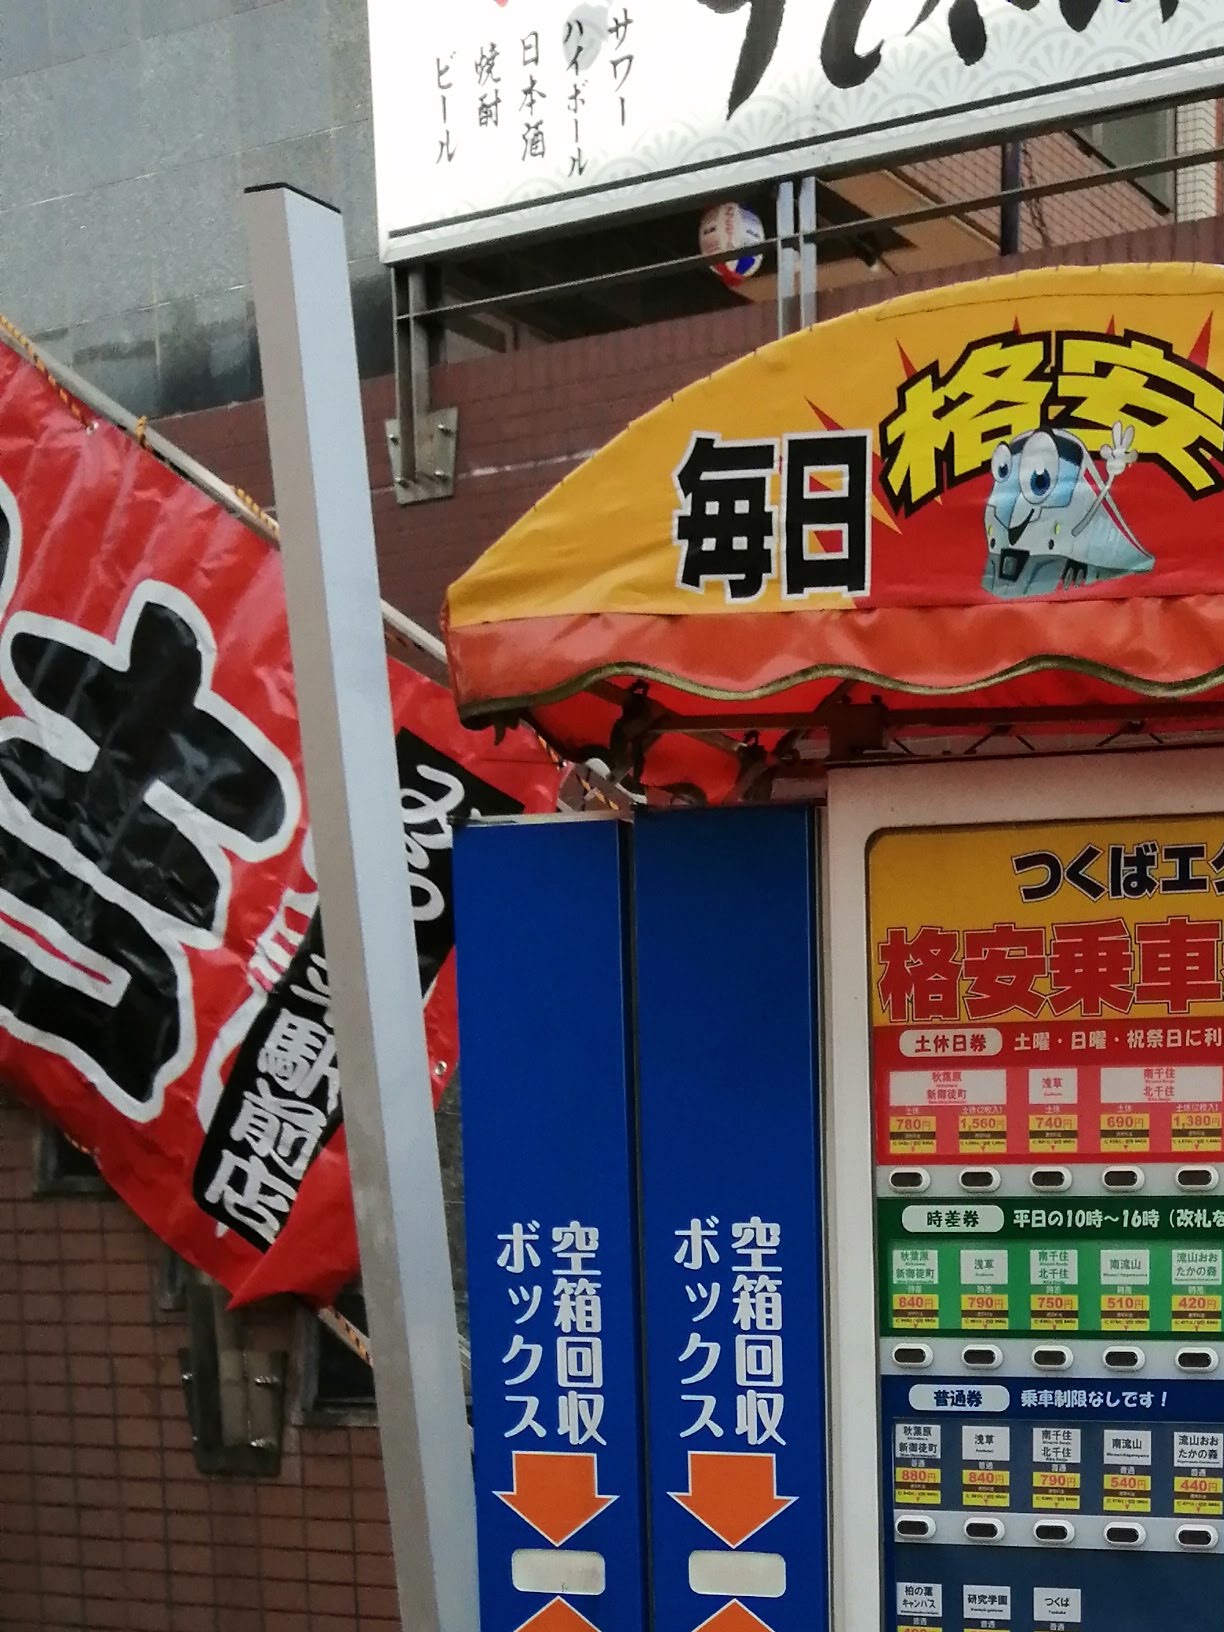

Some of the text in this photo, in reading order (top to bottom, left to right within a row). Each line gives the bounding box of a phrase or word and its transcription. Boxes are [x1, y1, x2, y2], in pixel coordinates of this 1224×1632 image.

[608, 8, 634, 126] サワー
[475, 42, 502, 127] 焼酎
[519, 31, 547, 162] 日本酒
[563, 20, 590, 178] ハイボール
[436, 51, 457, 164] ビール
[671, 431, 872, 602] 毎日
[914, 1031, 988, 1054] 土休日券
[1143, 1086, 1175, 1097] 北千住
[896, 1118, 931, 1131] 780円
[960, 1118, 1005, 1131] 1,560円
[1035, 1117, 1073, 1130] 740円
[1107, 1116, 1145, 1128] 690円
[1173, 1115, 1221, 1129] 1,380円
[926, 1210, 980, 1229] 時差券
[1038, 1250, 1069, 1262] 南千住
[1176, 1252, 1218, 1264] 流山おお
[1109, 1258, 1142, 1270] 南流山
[1038, 1268, 1070, 1279] 北千住
[968, 1296, 1004, 1309] 790円
[1037, 1296, 1073, 1309] 750円
[1107, 1297, 1144, 1309] 510円
[1178, 1297, 1217, 1309] 420円
[496, 1219, 547, 1438] ボックス
[552, 1220, 607, 1446] 空箱回収
[674, 1215, 725, 1438] ボックス
[731, 1215, 786, 1446] 空箱回収
[932, 1389, 1167, 1409] 普通券 乗車制限なしです！
[974, 1433, 995, 1446] 浅草
[1041, 1430, 1073, 1442] 南千住
[1178, 1435, 1219, 1446] 流山おお
[1111, 1438, 1143, 1450] 南流山
[1041, 1446, 1072, 1458] 北千住
[1178, 1449, 1219, 1460] たかの森
[902, 1470, 937, 1482] 880円
[968, 1472, 1004, 1484] 840円
[1040, 1474, 1077, 1487] 790円
[1110, 1477, 1147, 1490] 540円
[1180, 1480, 1219, 1492] 440円
[967, 1594, 1009, 1606] 研究学園
[1044, 1596, 1071, 1608] つくば
